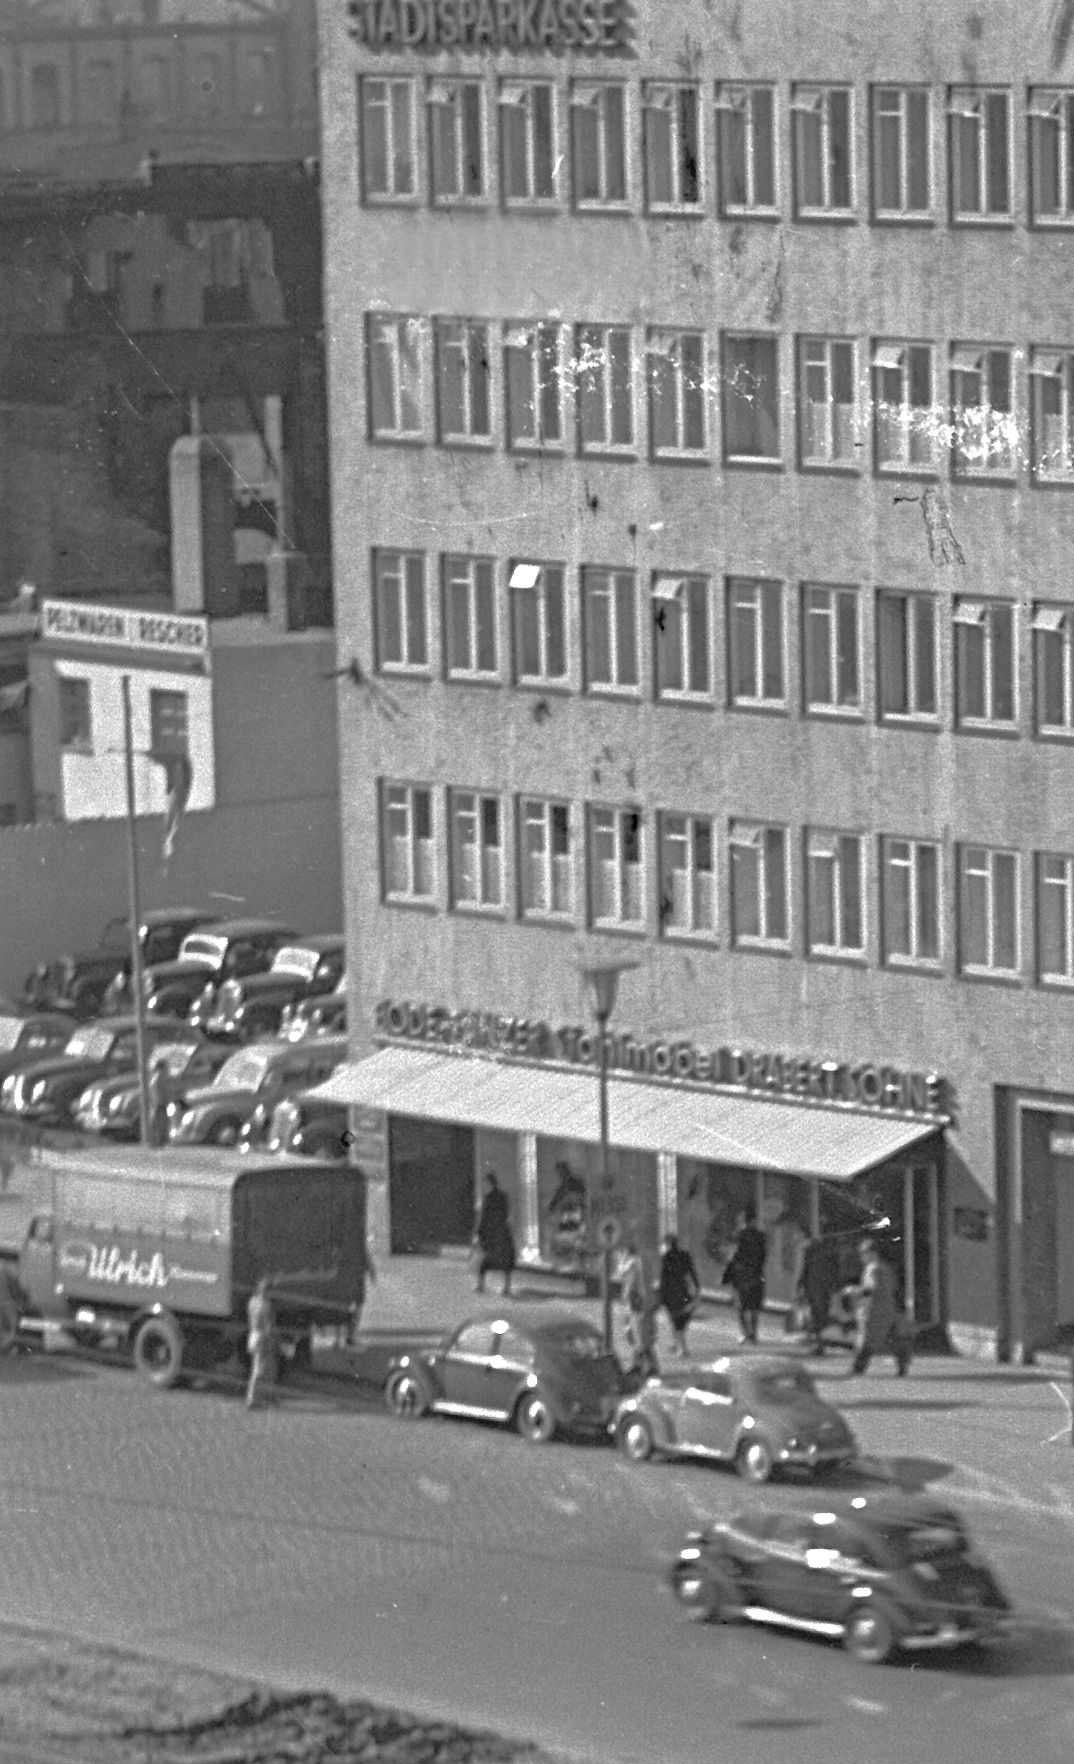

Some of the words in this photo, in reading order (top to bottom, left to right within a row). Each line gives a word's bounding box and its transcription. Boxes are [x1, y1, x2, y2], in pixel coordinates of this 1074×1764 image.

[47, 607, 125, 639] PELZWAREN
[140, 617, 202, 647] RESCHER
[84, 1243, 168, 1287] Ulrich
